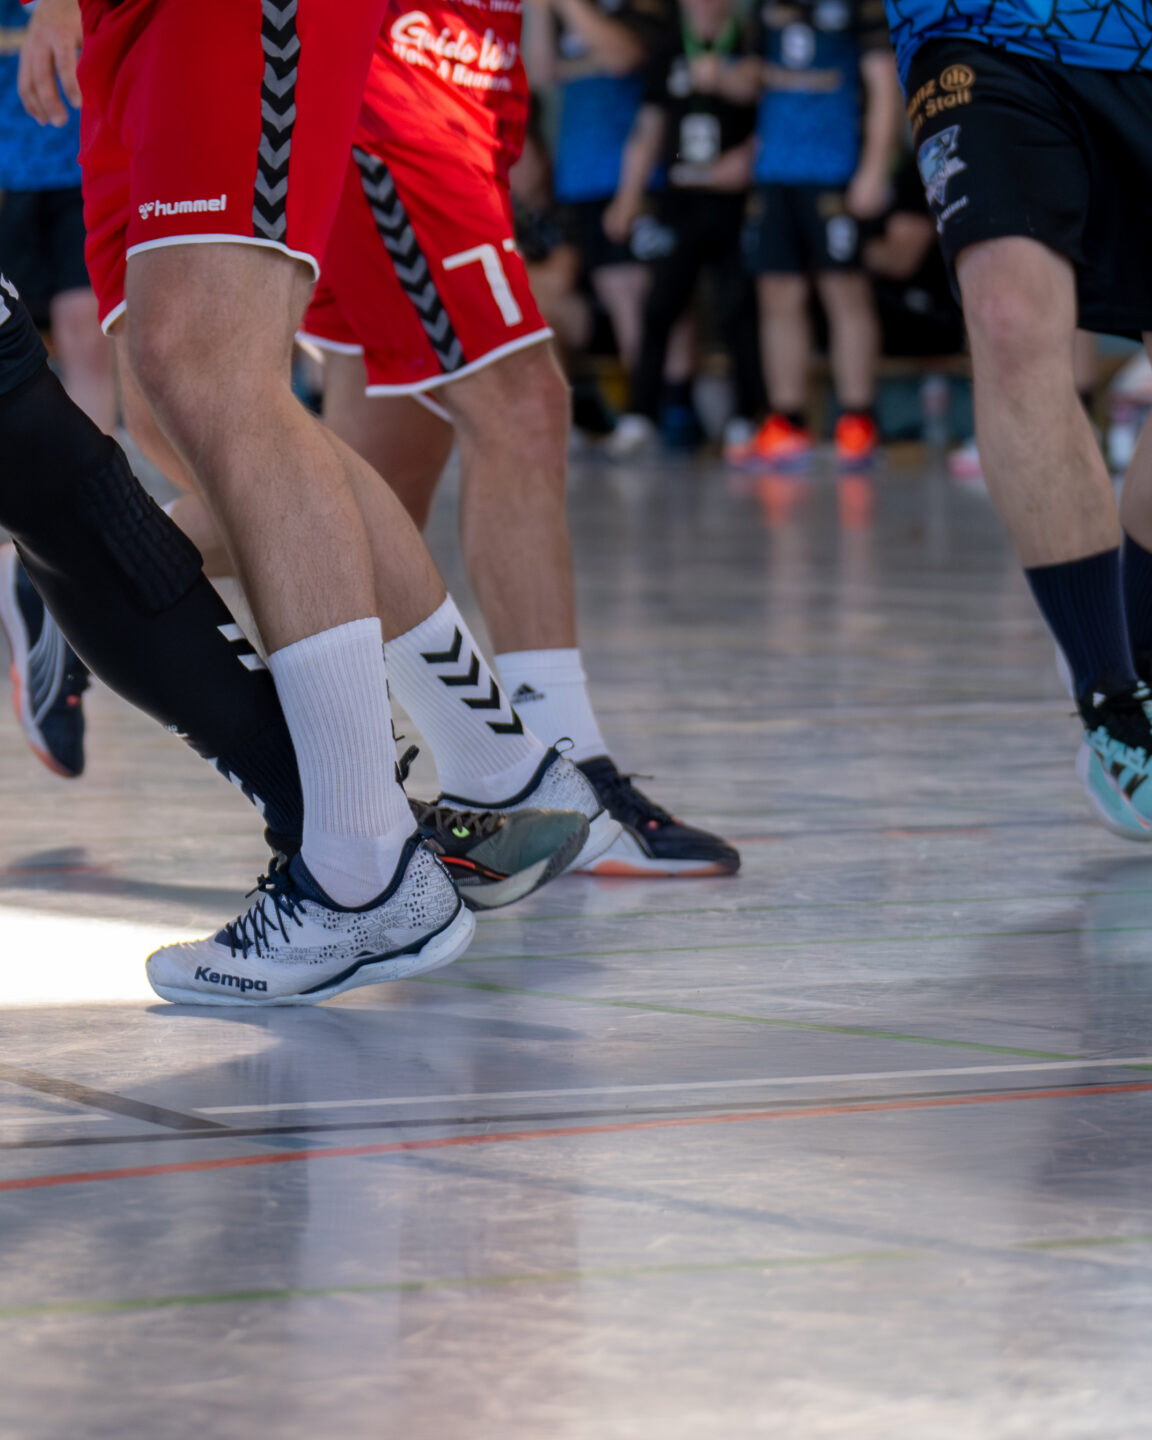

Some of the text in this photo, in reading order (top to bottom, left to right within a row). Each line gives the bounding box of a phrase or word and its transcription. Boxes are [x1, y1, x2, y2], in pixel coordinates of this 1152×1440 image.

[154, 193, 227, 217] hummel
[442, 238, 523, 328] 7
[194, 966, 268, 993] Kempa
